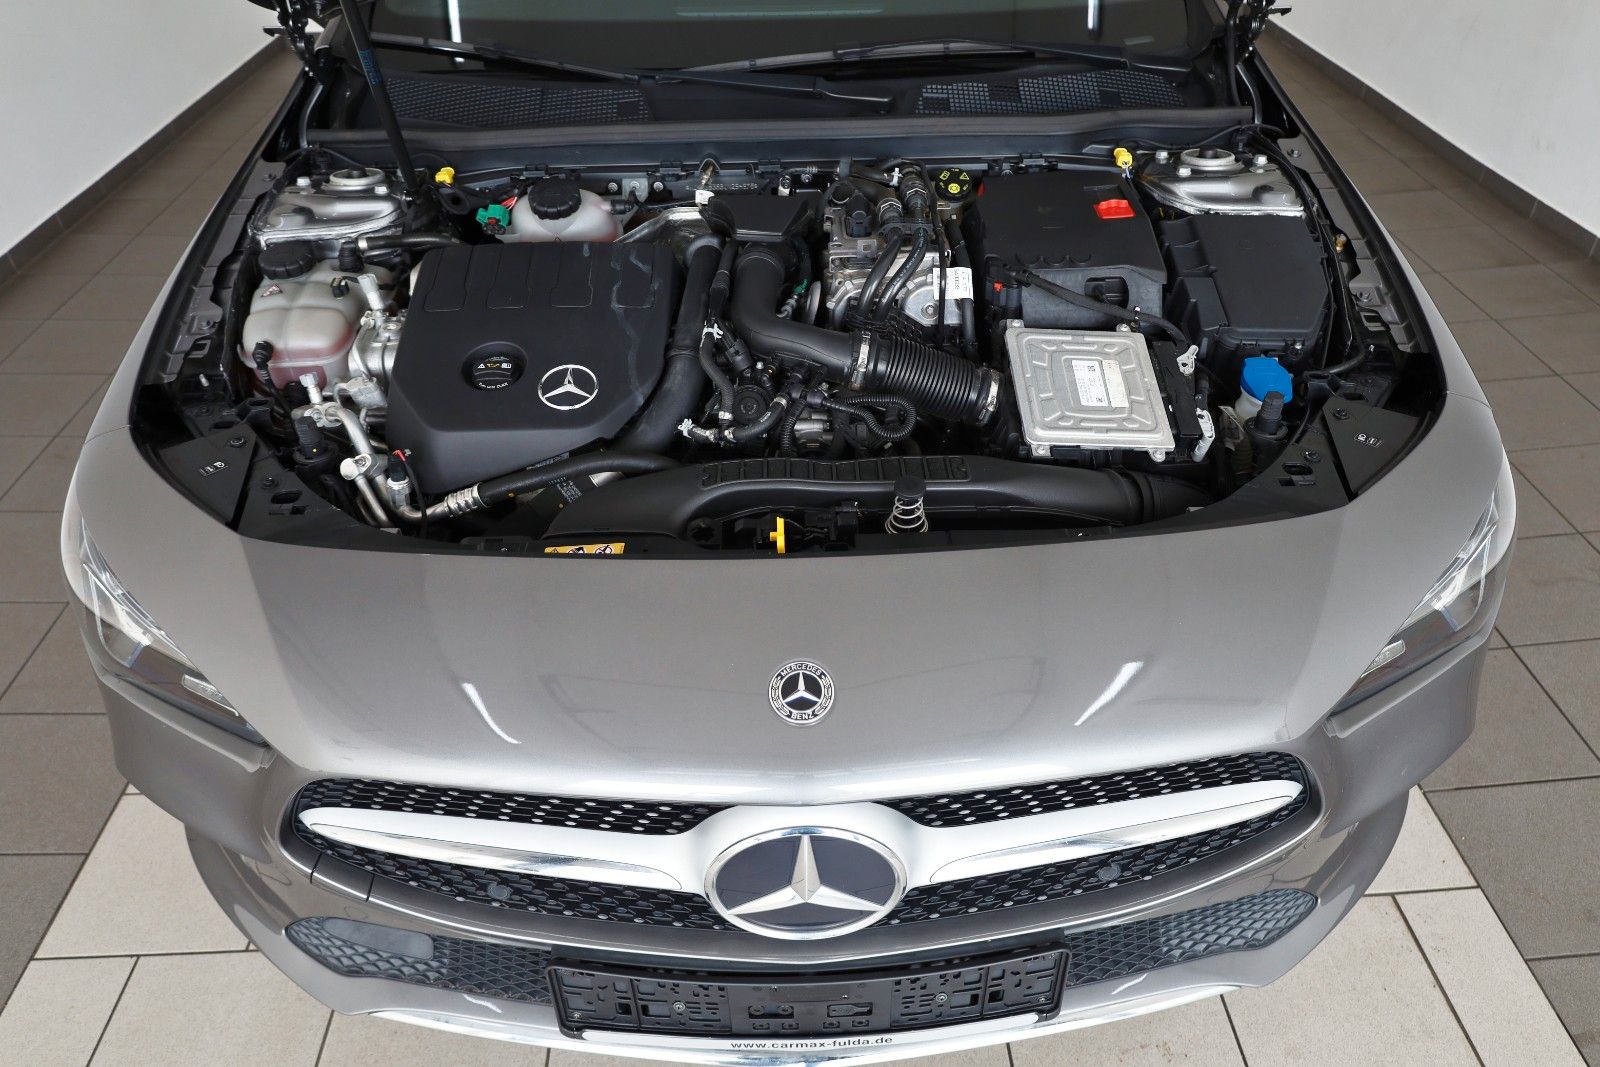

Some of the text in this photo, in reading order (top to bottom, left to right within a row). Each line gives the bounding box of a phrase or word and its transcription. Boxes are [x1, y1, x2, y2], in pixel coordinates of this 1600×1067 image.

[780, 663, 822, 677] MERCEDES
[790, 711, 815, 720] BENZ
[730, 1036, 893, 1049] www.carmax-fulda.de
